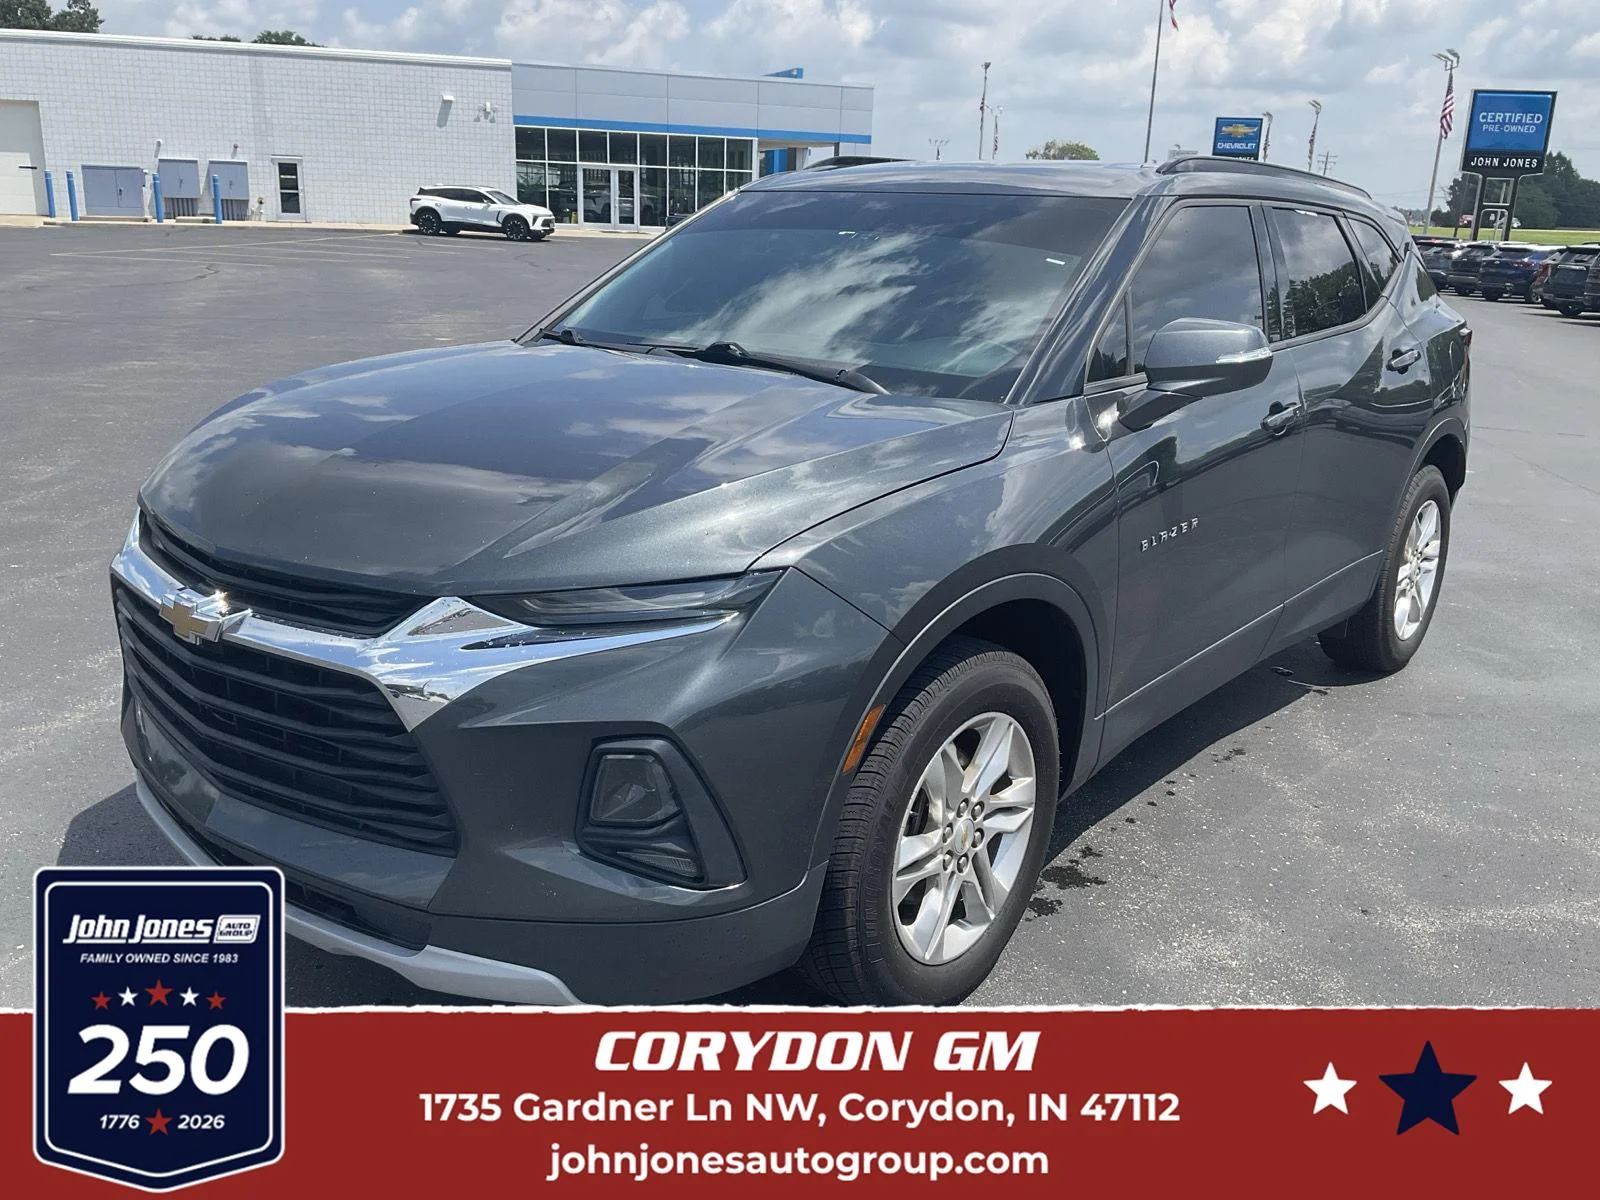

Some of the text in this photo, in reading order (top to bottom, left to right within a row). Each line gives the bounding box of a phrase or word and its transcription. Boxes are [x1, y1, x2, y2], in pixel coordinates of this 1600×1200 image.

[1479, 112, 1543, 124] CERTIFIED
[1482, 124, 1536, 133] PRE-OWNED
[1217, 142, 1256, 150] CHEVROLET
[1471, 157, 1538, 168] JOHN JONES
[1141, 517, 1199, 552] BLAZER
